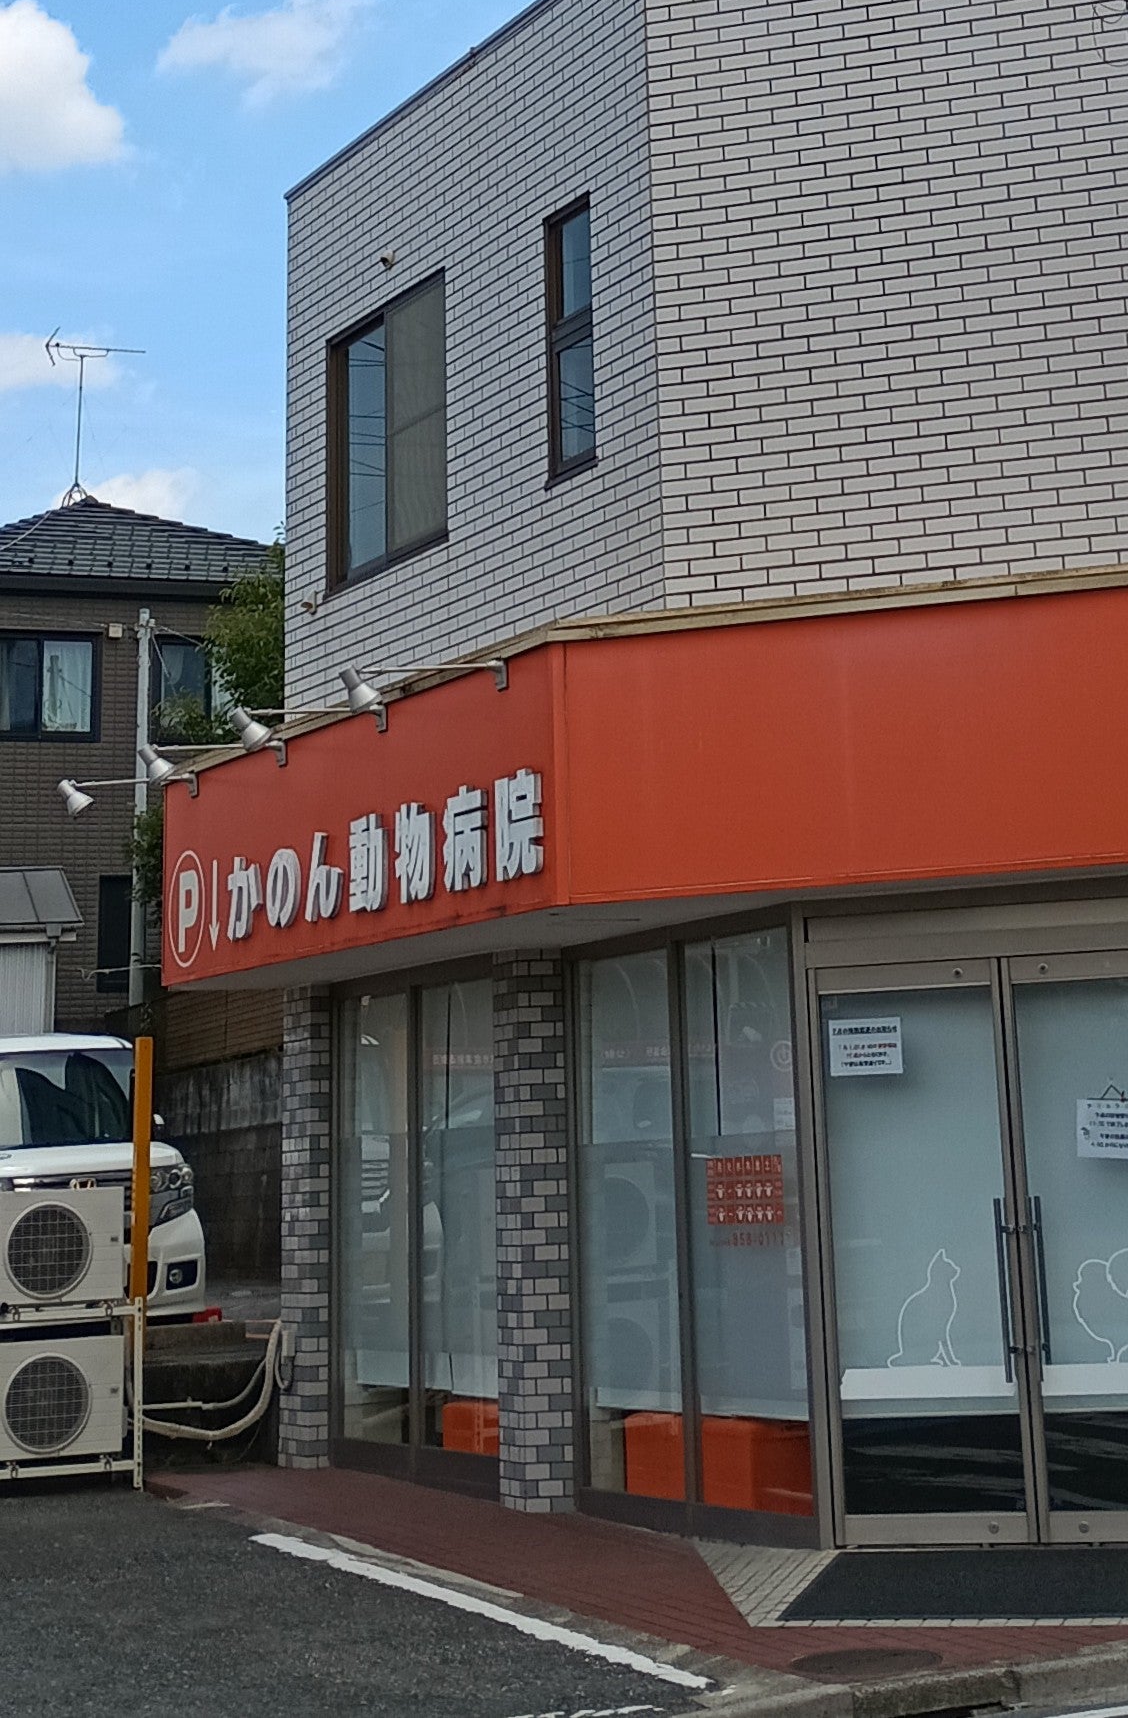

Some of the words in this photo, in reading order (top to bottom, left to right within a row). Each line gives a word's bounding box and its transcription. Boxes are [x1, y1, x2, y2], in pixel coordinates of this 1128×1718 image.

[178, 869, 200, 954] P
[227, 768, 544, 943] かのん動物病院
